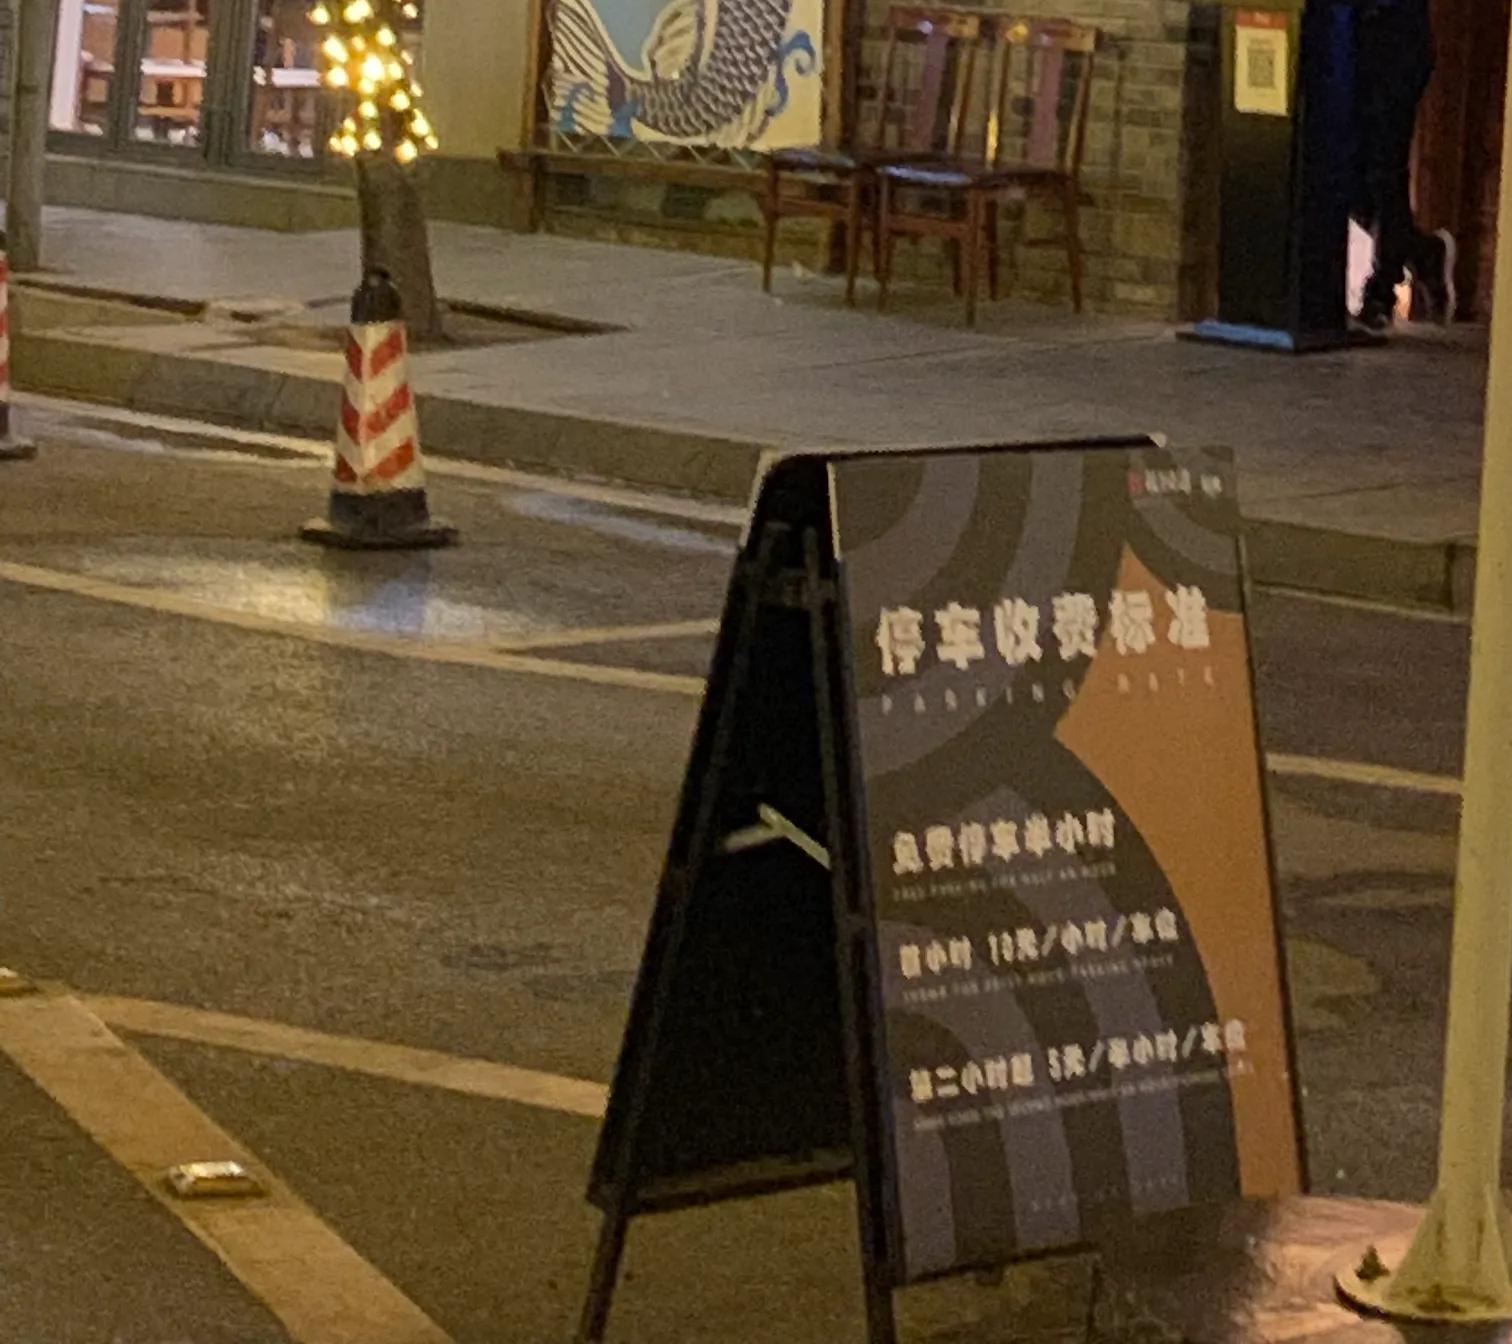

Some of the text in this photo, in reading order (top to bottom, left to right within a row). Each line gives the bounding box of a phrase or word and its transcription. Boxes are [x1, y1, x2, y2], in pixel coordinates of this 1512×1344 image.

[876, 583, 1210, 675] 停车收费标准
